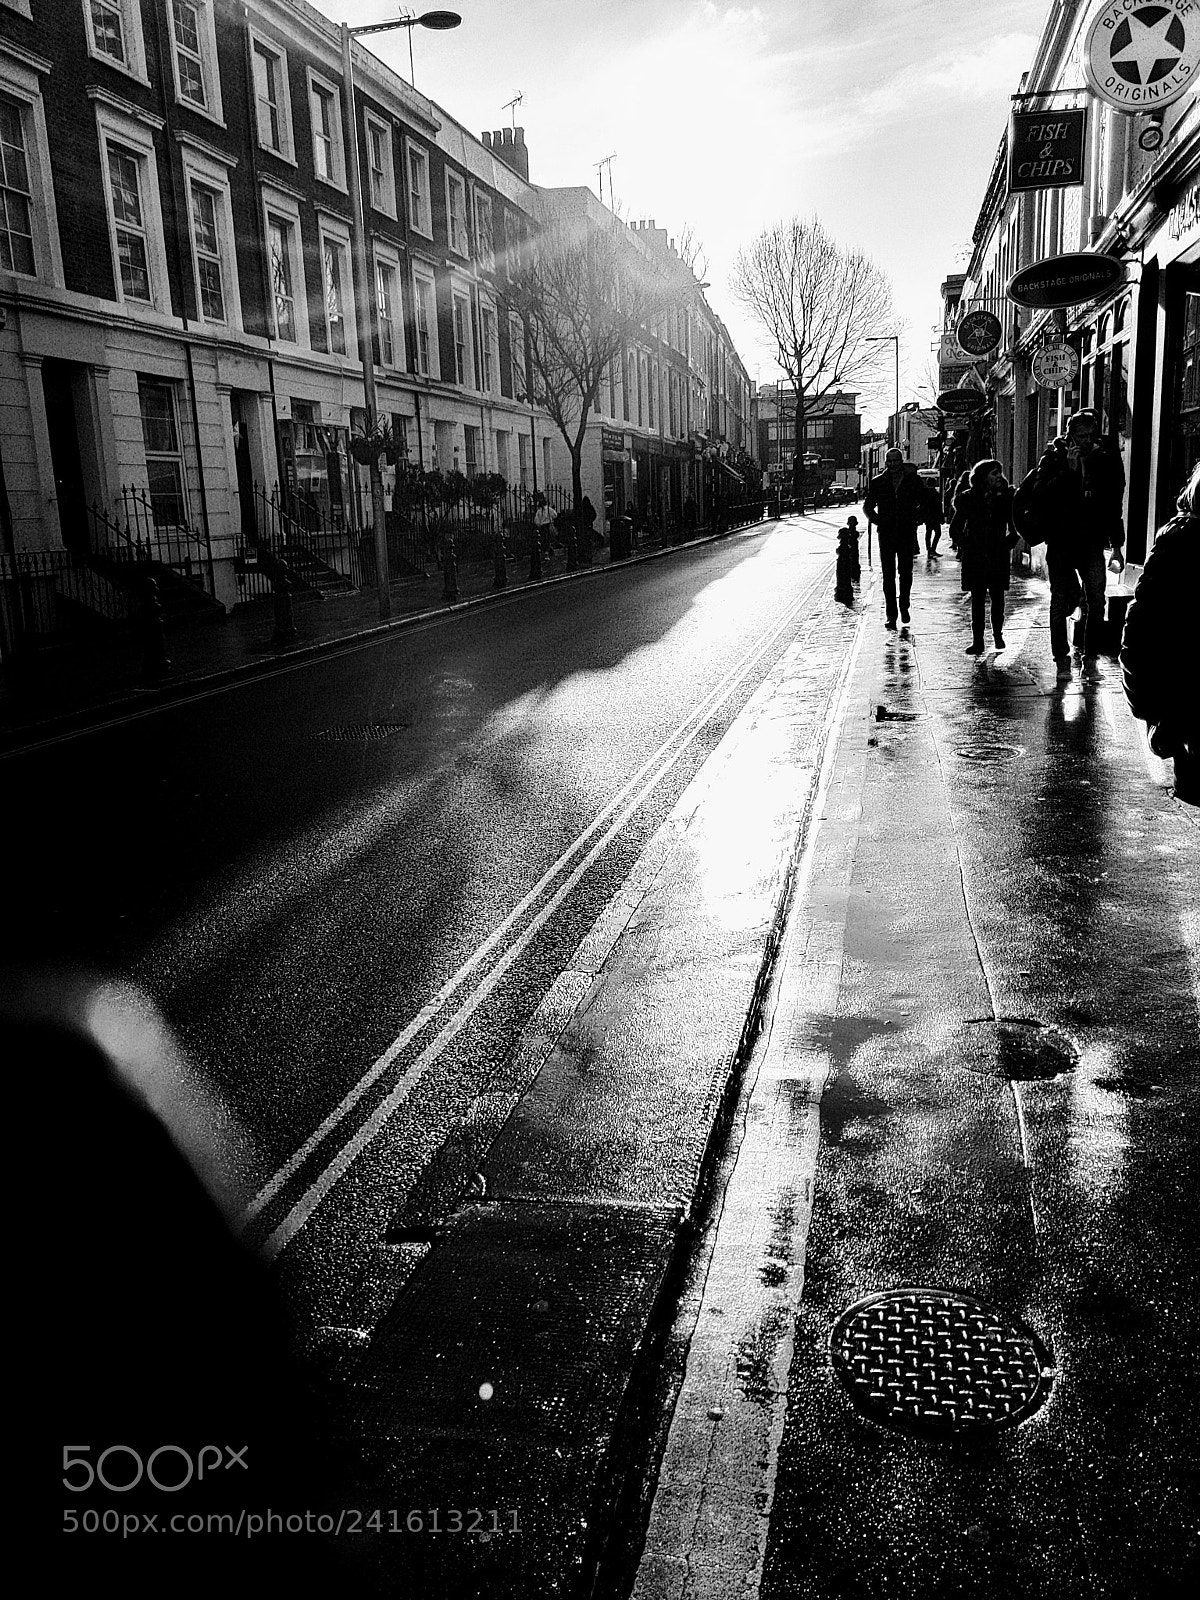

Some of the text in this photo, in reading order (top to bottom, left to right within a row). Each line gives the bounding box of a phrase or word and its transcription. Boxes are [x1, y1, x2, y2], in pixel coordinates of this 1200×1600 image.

[1105, 63, 1191, 101] ORIGINALS
[1026, 122, 1072, 142] FISH
[1039, 142, 1054, 159] &
[1017, 158, 1075, 178] CHIPS
[1018, 270, 1112, 292] BACKSTAGE ORIGINALS
[1045, 354, 1065, 362] FISH
[1043, 366, 1069, 374] CHIPS
